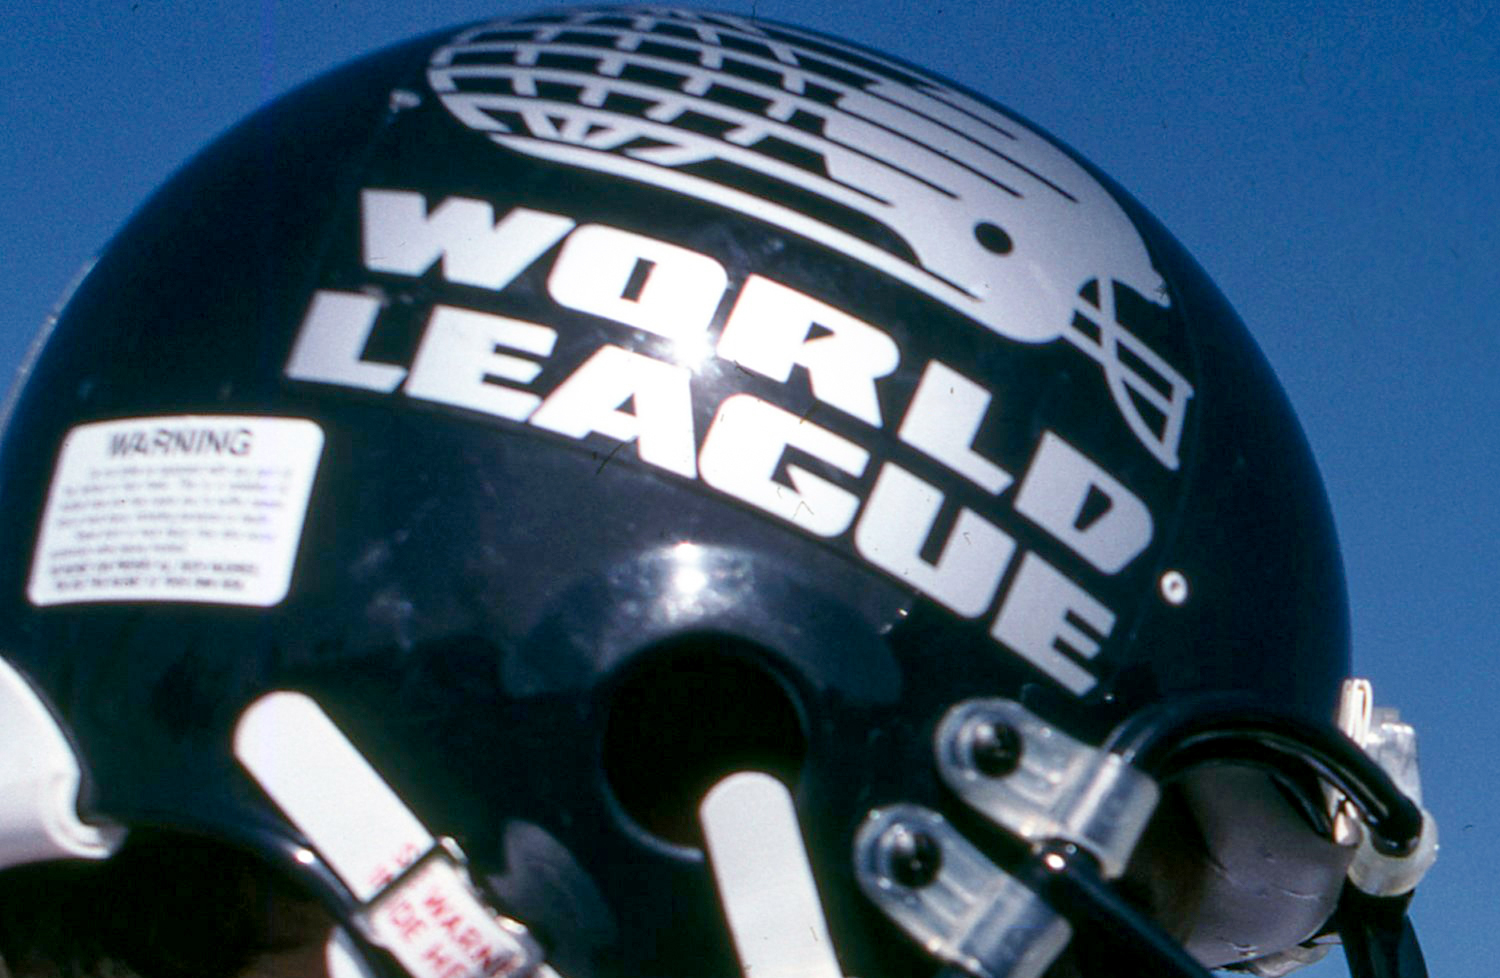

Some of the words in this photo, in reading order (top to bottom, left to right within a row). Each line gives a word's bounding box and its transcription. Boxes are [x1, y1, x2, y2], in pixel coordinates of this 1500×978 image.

[107, 427, 254, 457] WARNING
[285, 290, 1117, 697] LEAGUE
[361, 189, 1154, 576] WORLD
